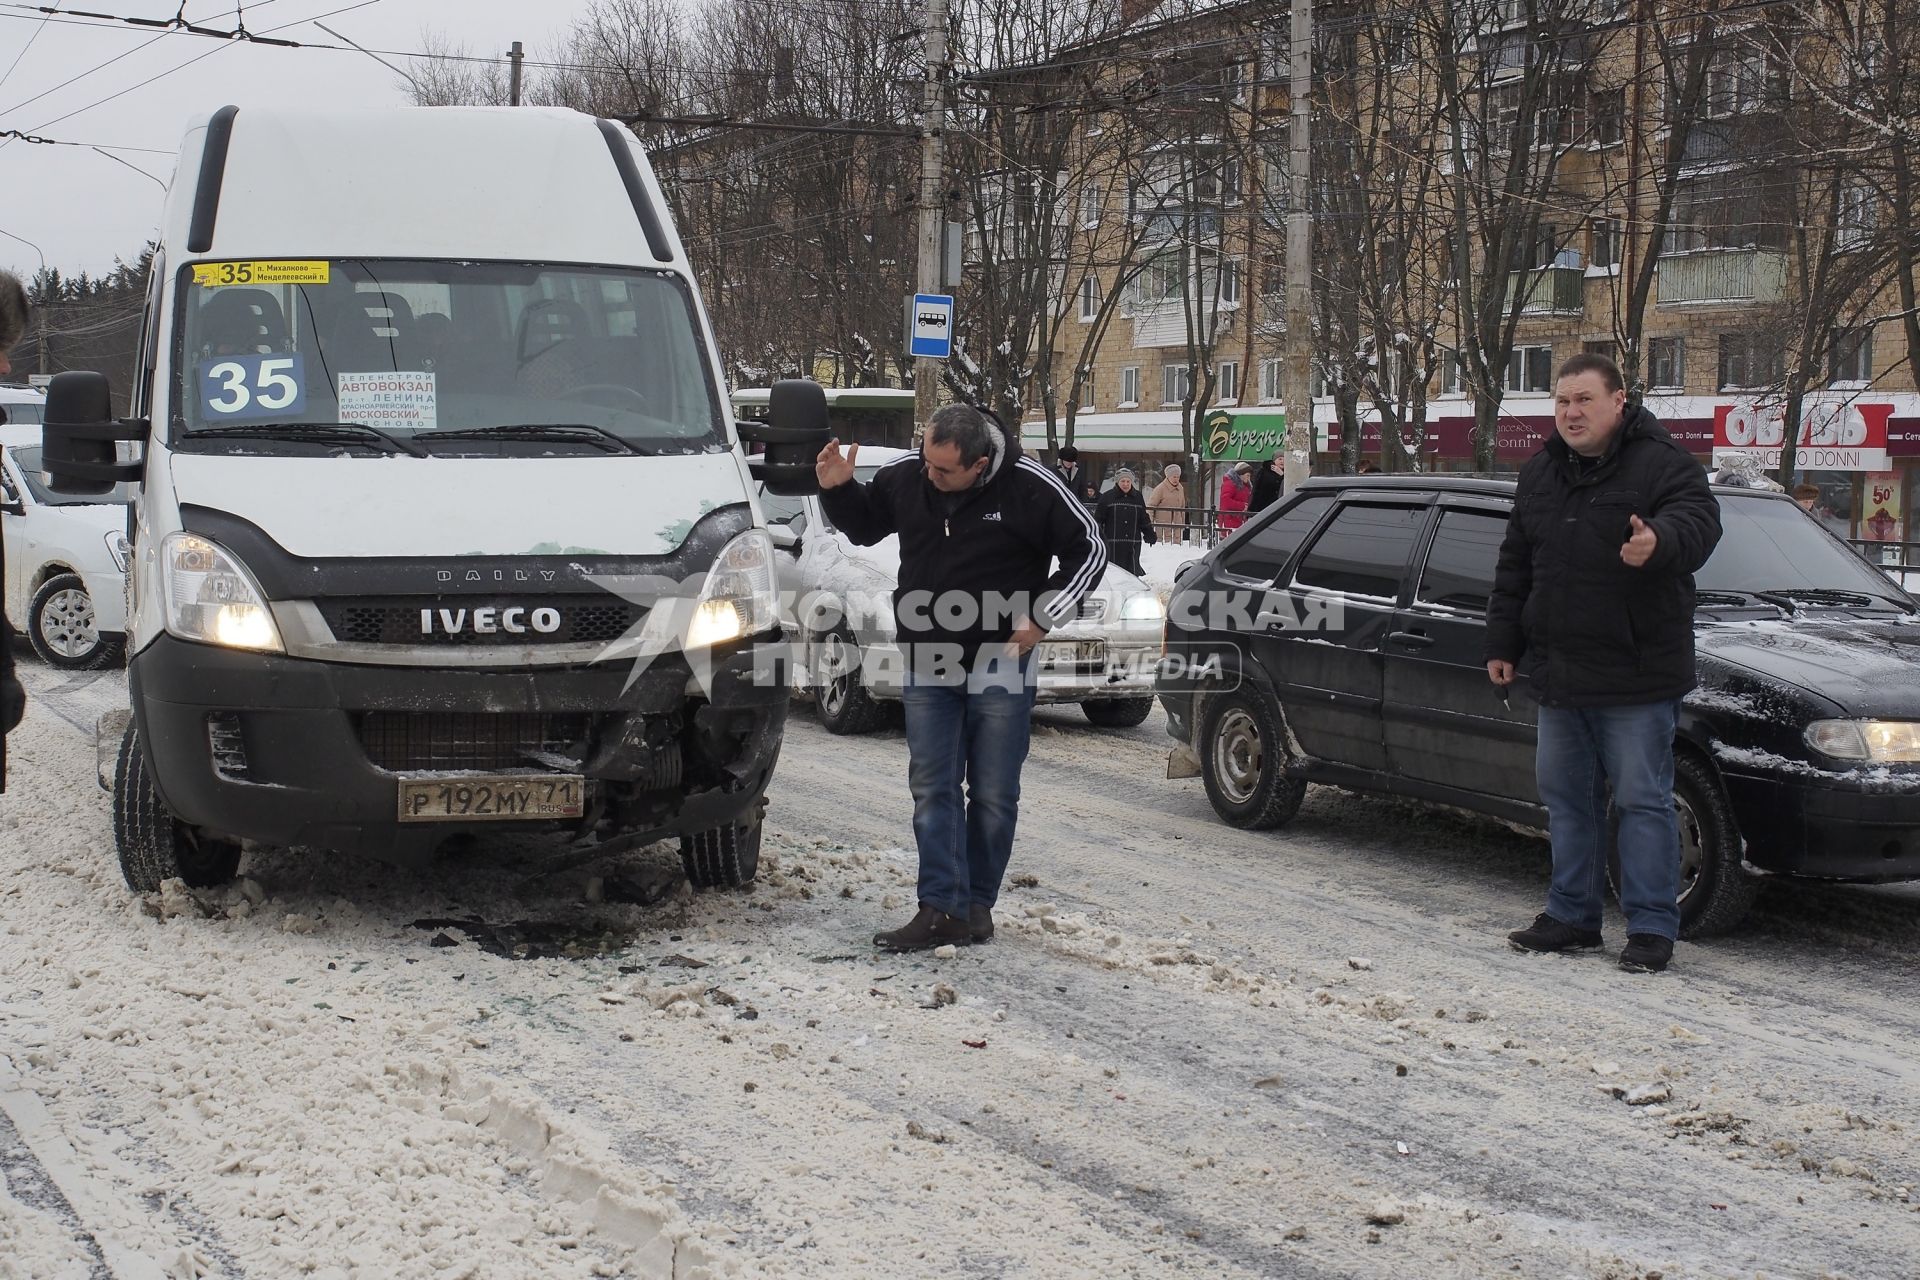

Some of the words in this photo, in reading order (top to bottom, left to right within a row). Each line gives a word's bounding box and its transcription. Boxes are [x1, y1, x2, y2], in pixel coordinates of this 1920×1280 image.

[266, 264, 309, 272] Михалково
[220, 263, 252, 284] 35
[257, 272, 317, 281] Менделеевский
[340, 374, 432, 382] ЗЕЛЕНСТРОЙ
[208, 358, 298, 413] 35
[341, 381, 433, 392] АВТОВОКЗАЛ
[373, 393, 434, 403] ЛЕНИНА
[341, 402, 415, 410] КРАСНОАРМЕЙСКИЙ
[341, 409, 420, 419] МОСКОВСКИЙ
[1814, 450, 1860, 467] DONNI
[437, 570, 555, 581] DAILY
[421, 607, 561, 634] IVECO
[540, 804, 563, 813] RUS
